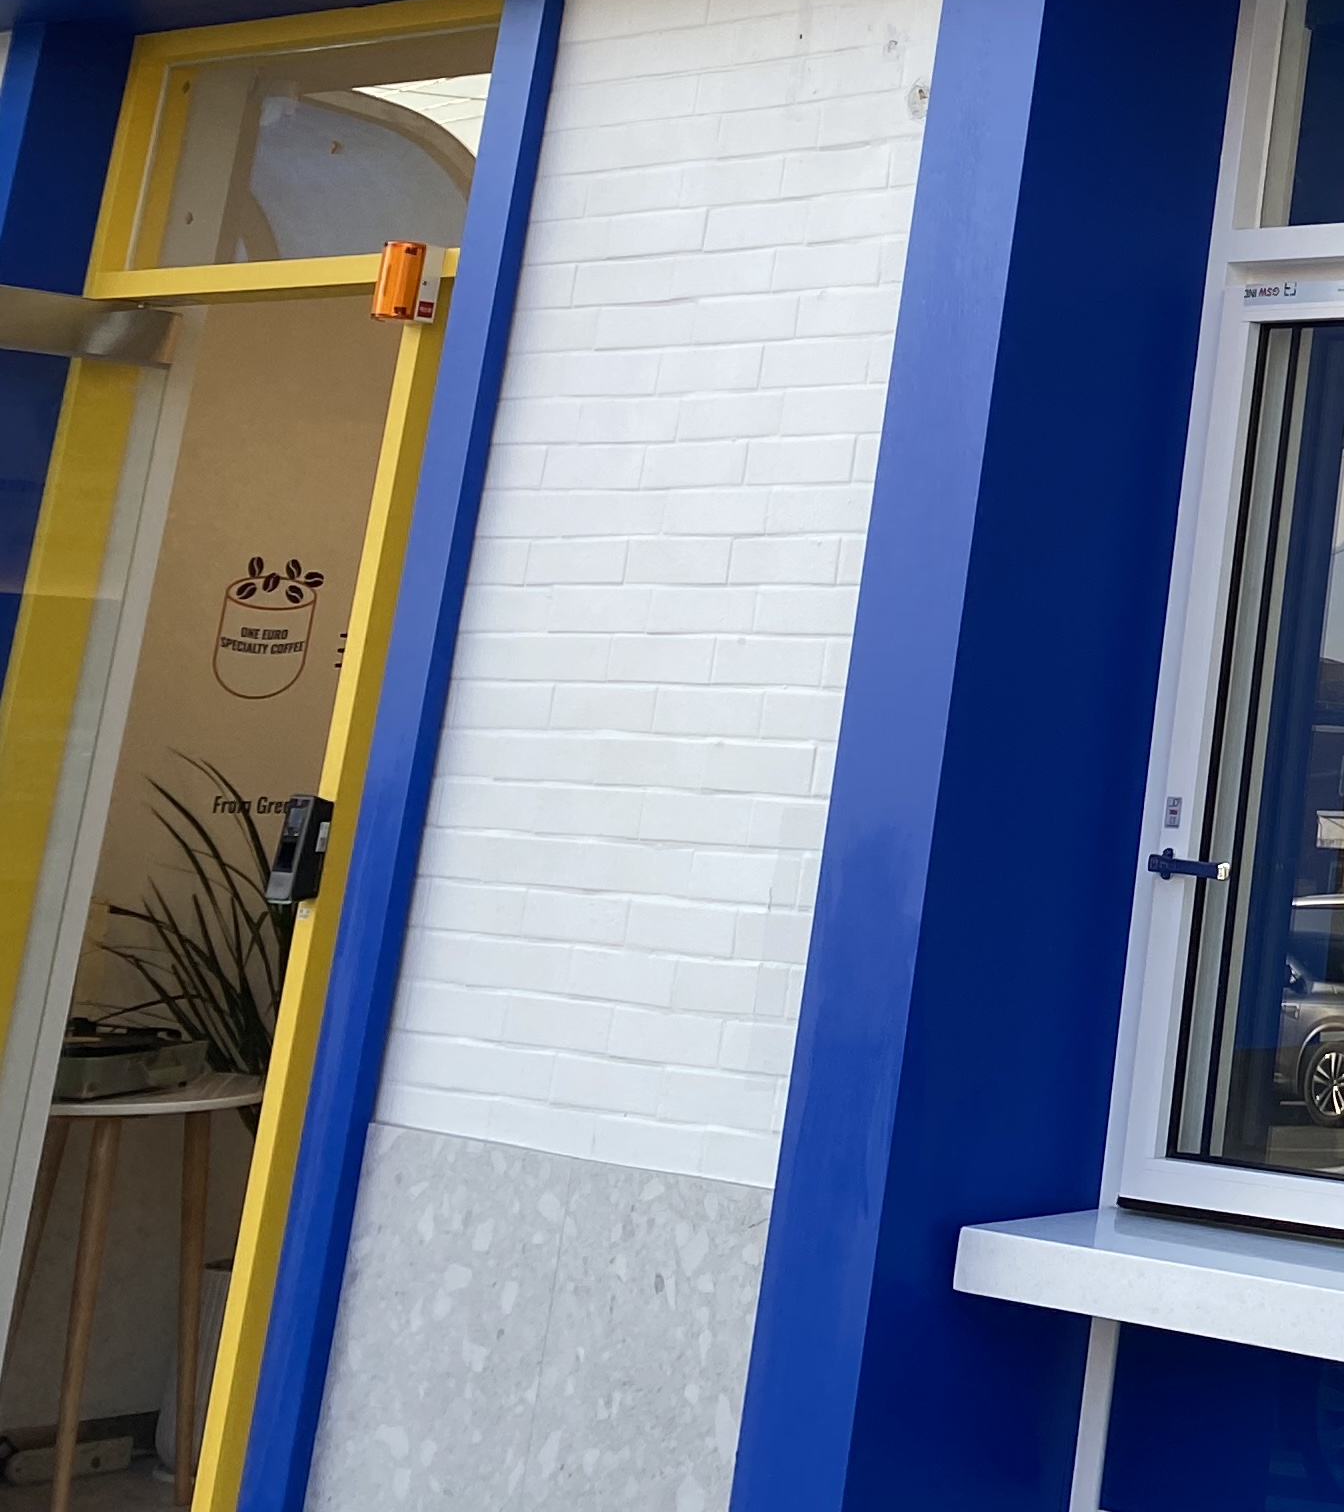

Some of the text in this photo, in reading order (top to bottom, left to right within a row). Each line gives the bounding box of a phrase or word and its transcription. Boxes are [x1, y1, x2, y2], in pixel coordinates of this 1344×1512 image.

[220, 636, 306, 655] SPECIALTY COFFEE
[213, 795, 252, 814] From
